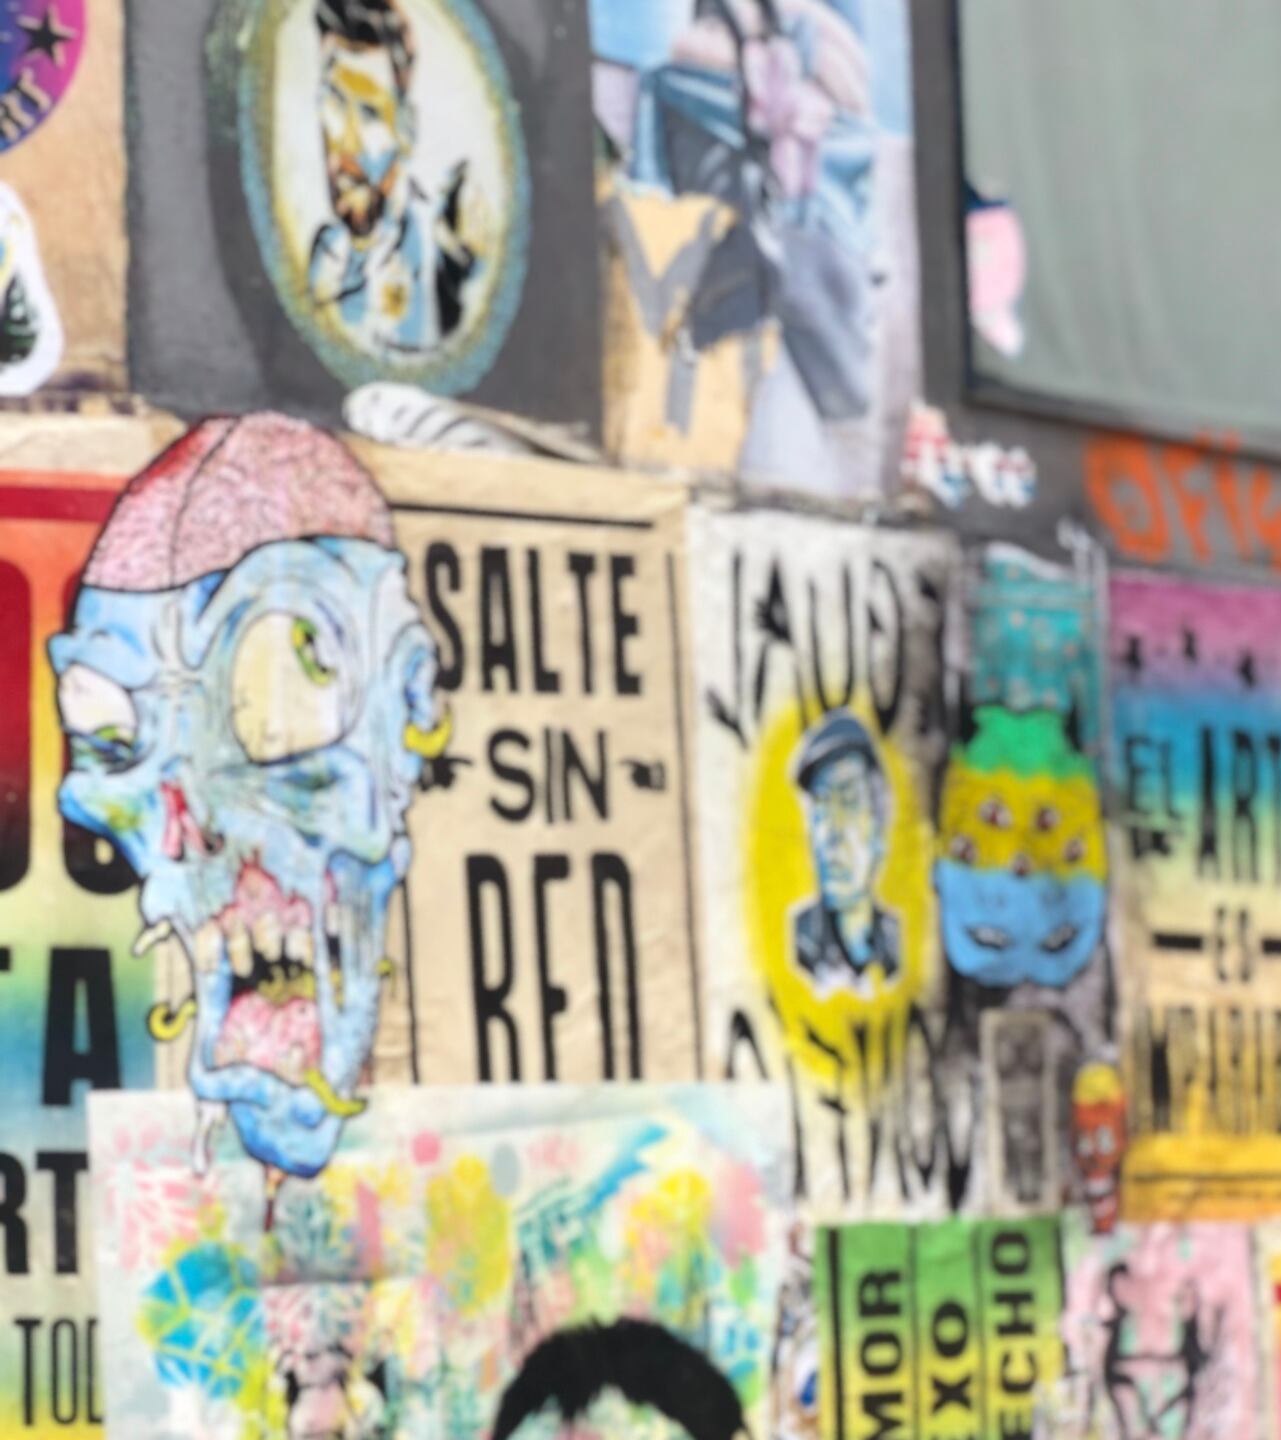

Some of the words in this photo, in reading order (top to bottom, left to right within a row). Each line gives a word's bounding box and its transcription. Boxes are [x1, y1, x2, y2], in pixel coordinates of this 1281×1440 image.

[425, 541, 641, 695] SALTE
[487, 728, 609, 823] SIN
[466, 853, 641, 1084] RED
